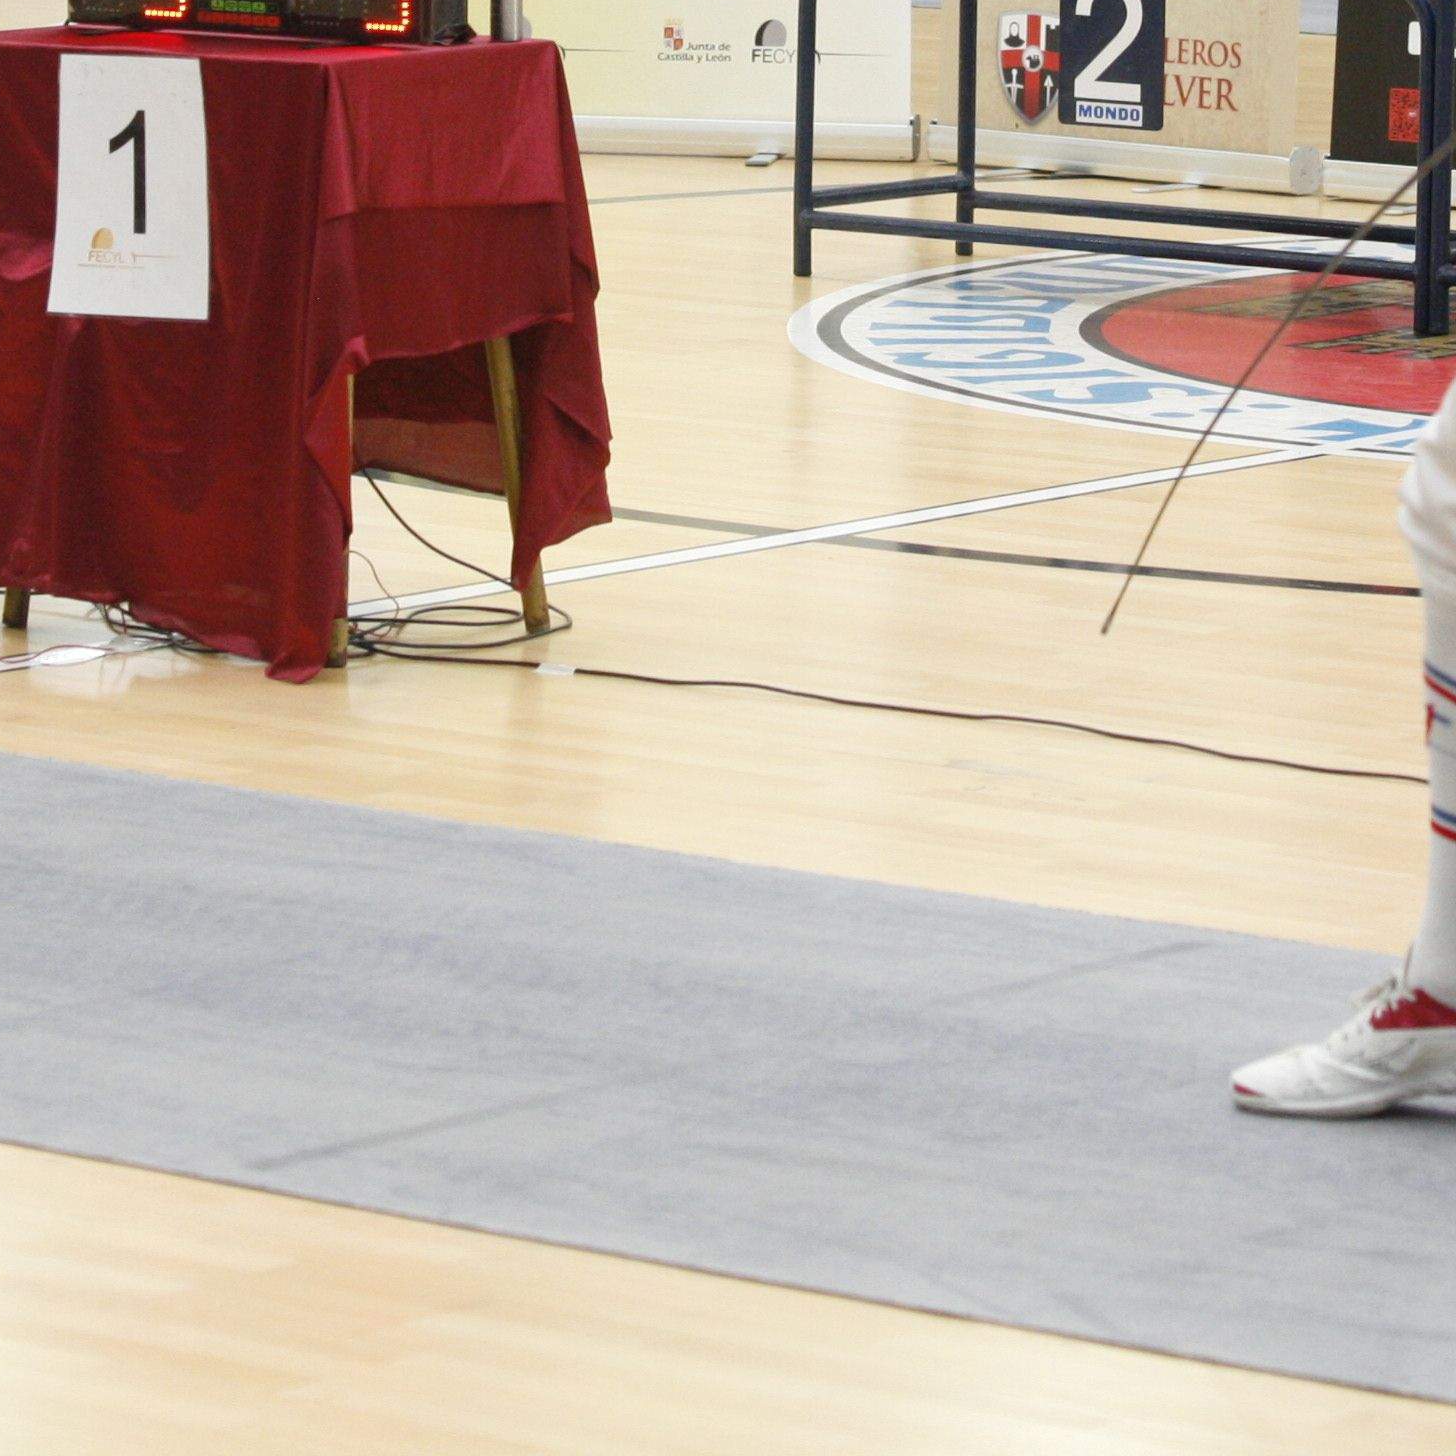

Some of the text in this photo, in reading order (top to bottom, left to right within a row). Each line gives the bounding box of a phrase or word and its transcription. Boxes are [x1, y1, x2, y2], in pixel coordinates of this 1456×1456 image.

[686, 42, 731, 52] Junta de
[751, 47, 796, 64] FECY
[1164, 36, 1243, 70] LEROS
[656, 52, 732, 62] Castilla León
[1163, 73, 1239, 112] LVER
[1077, 103, 1141, 122] MONDO
[108, 109, 147, 235] 1
